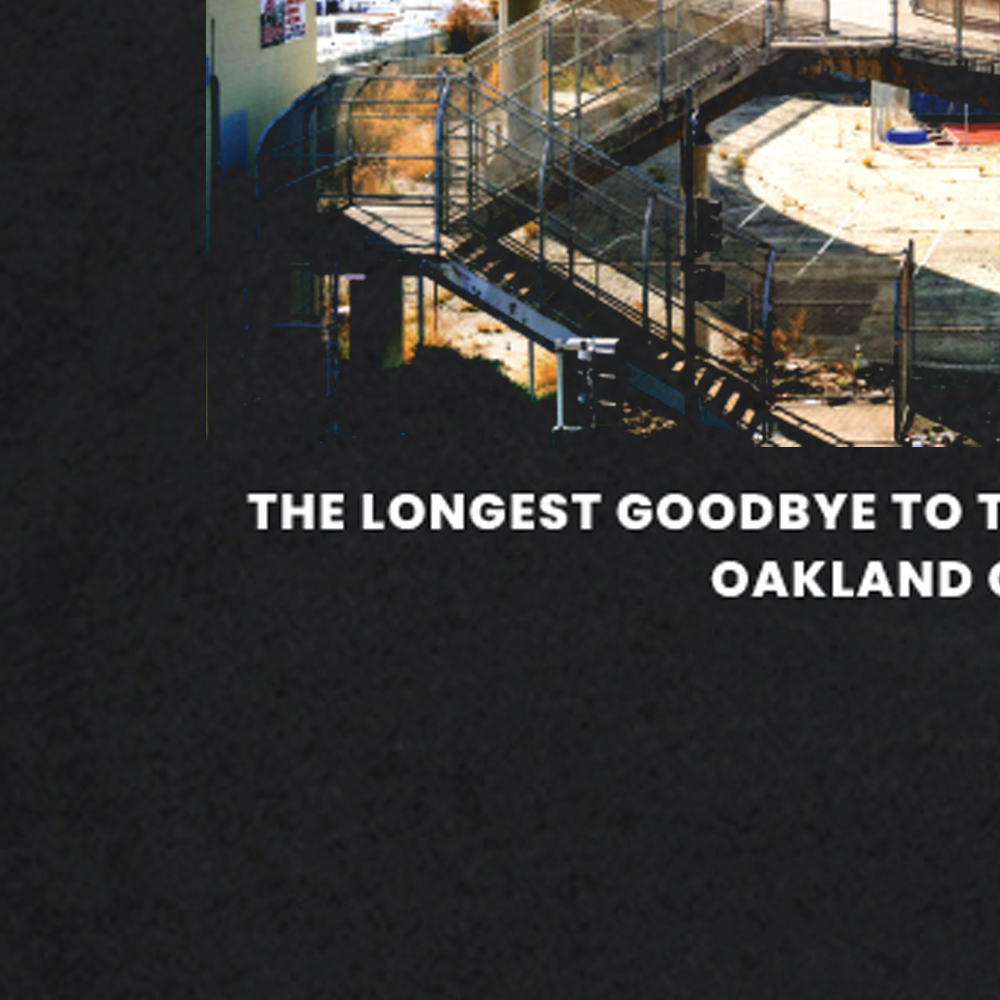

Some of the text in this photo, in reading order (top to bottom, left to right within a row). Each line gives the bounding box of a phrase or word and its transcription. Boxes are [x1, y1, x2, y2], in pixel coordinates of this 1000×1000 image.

[247, 493, 345, 530] THE
[362, 493, 602, 530] LONGEST
[616, 493, 876, 530] GOODBYE
[891, 493, 963, 530] TO
[711, 560, 973, 598] OAKLAND
